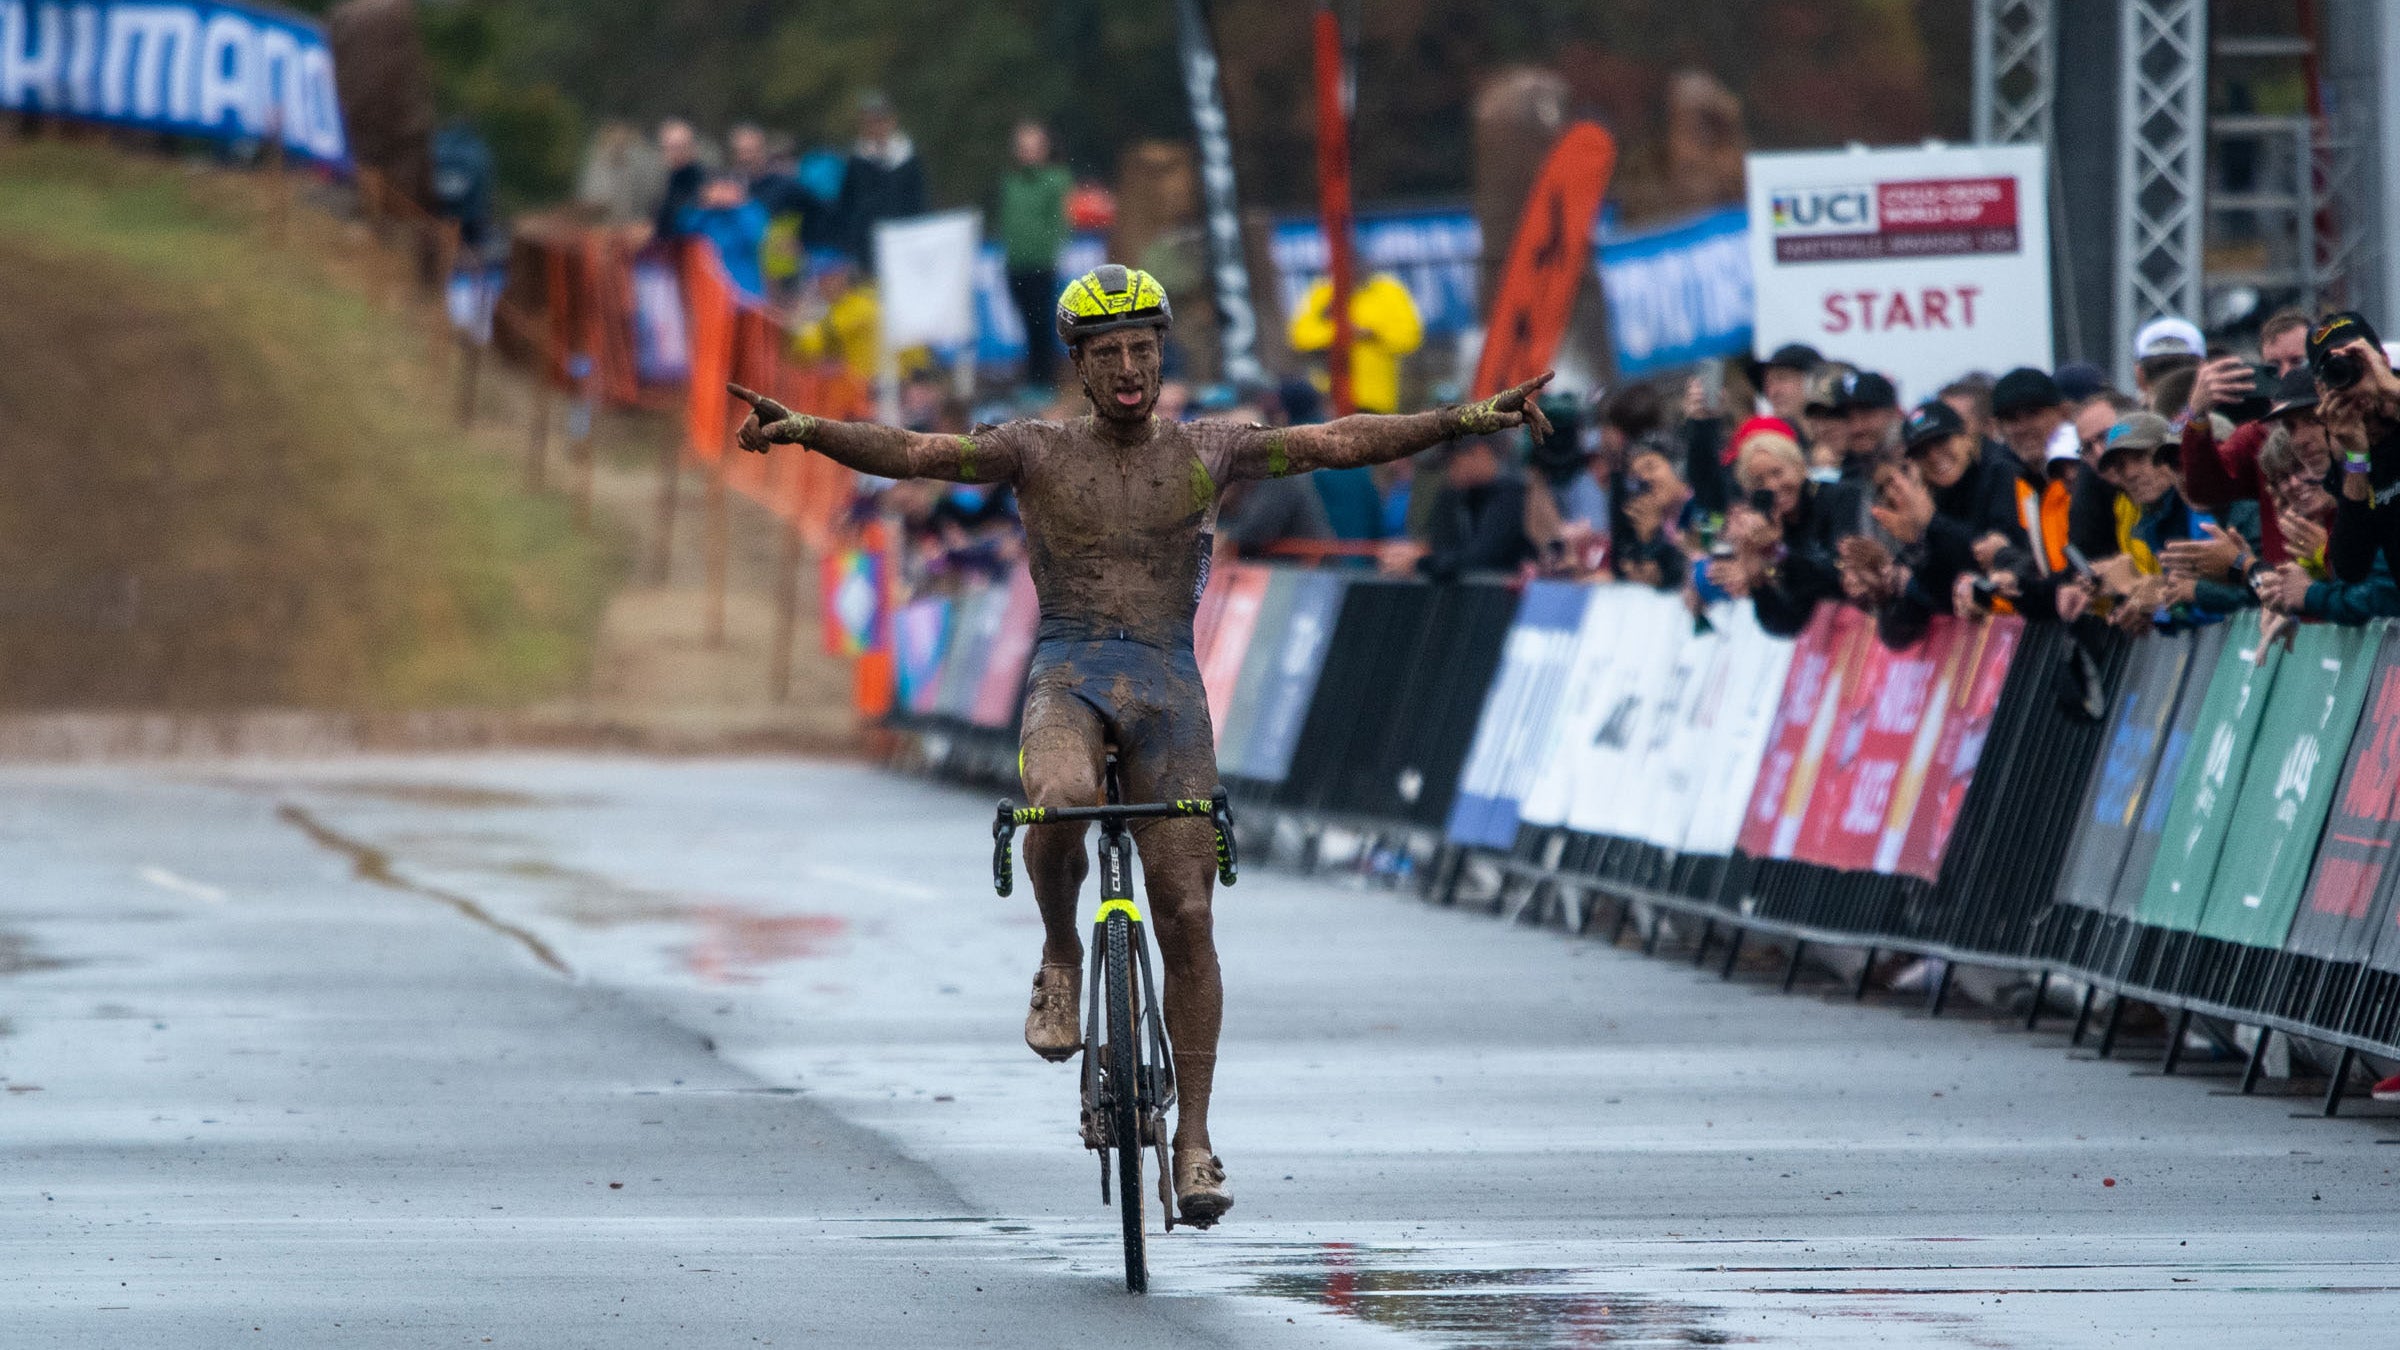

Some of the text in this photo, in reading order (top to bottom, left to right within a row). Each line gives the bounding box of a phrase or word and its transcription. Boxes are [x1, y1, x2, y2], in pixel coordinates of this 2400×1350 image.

[0, 2, 345, 160] HIMANO
[1791, 192, 1868, 226] UCI
[1823, 285, 1981, 334] START
[1110, 846, 1121, 892] CUBE
